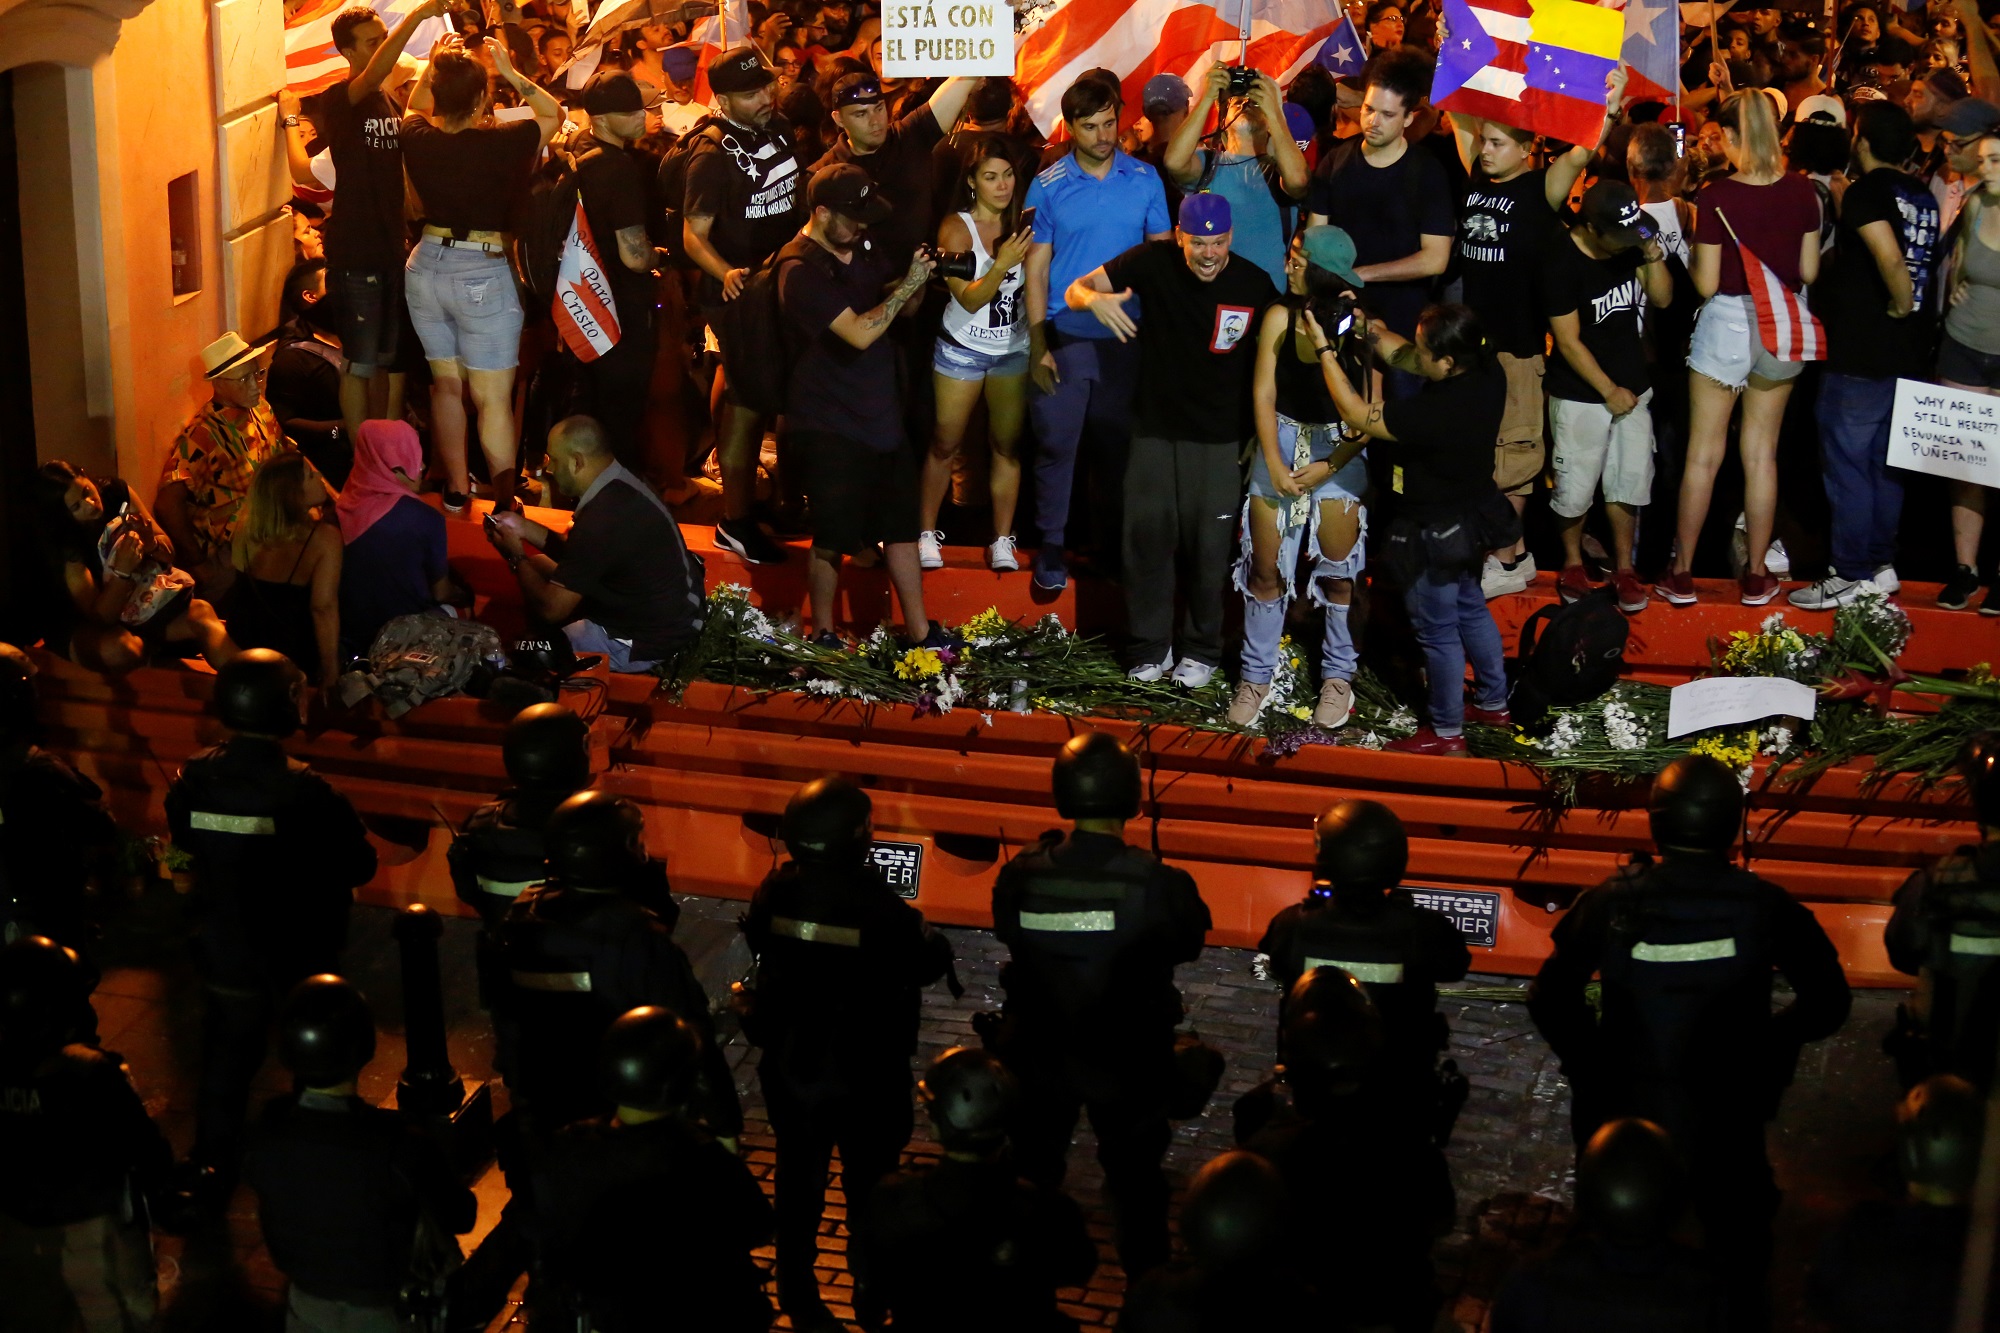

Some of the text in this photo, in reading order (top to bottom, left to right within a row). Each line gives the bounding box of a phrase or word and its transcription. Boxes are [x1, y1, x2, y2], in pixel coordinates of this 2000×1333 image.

[886, 0, 994, 28] ESTÁ CON
[886, 38, 995, 61] EL PUEBLO
[745, 205, 767, 219] AHORA
[583, 267, 611, 308] Para
[561, 290, 599, 338] Cristo
[1914, 396, 1993, 417] WHY ARE WE
[1914, 412, 1952, 427] STILL
[1902, 426, 1986, 451] RENUNCIA YA
[1411, 893, 1493, 915] RITON
